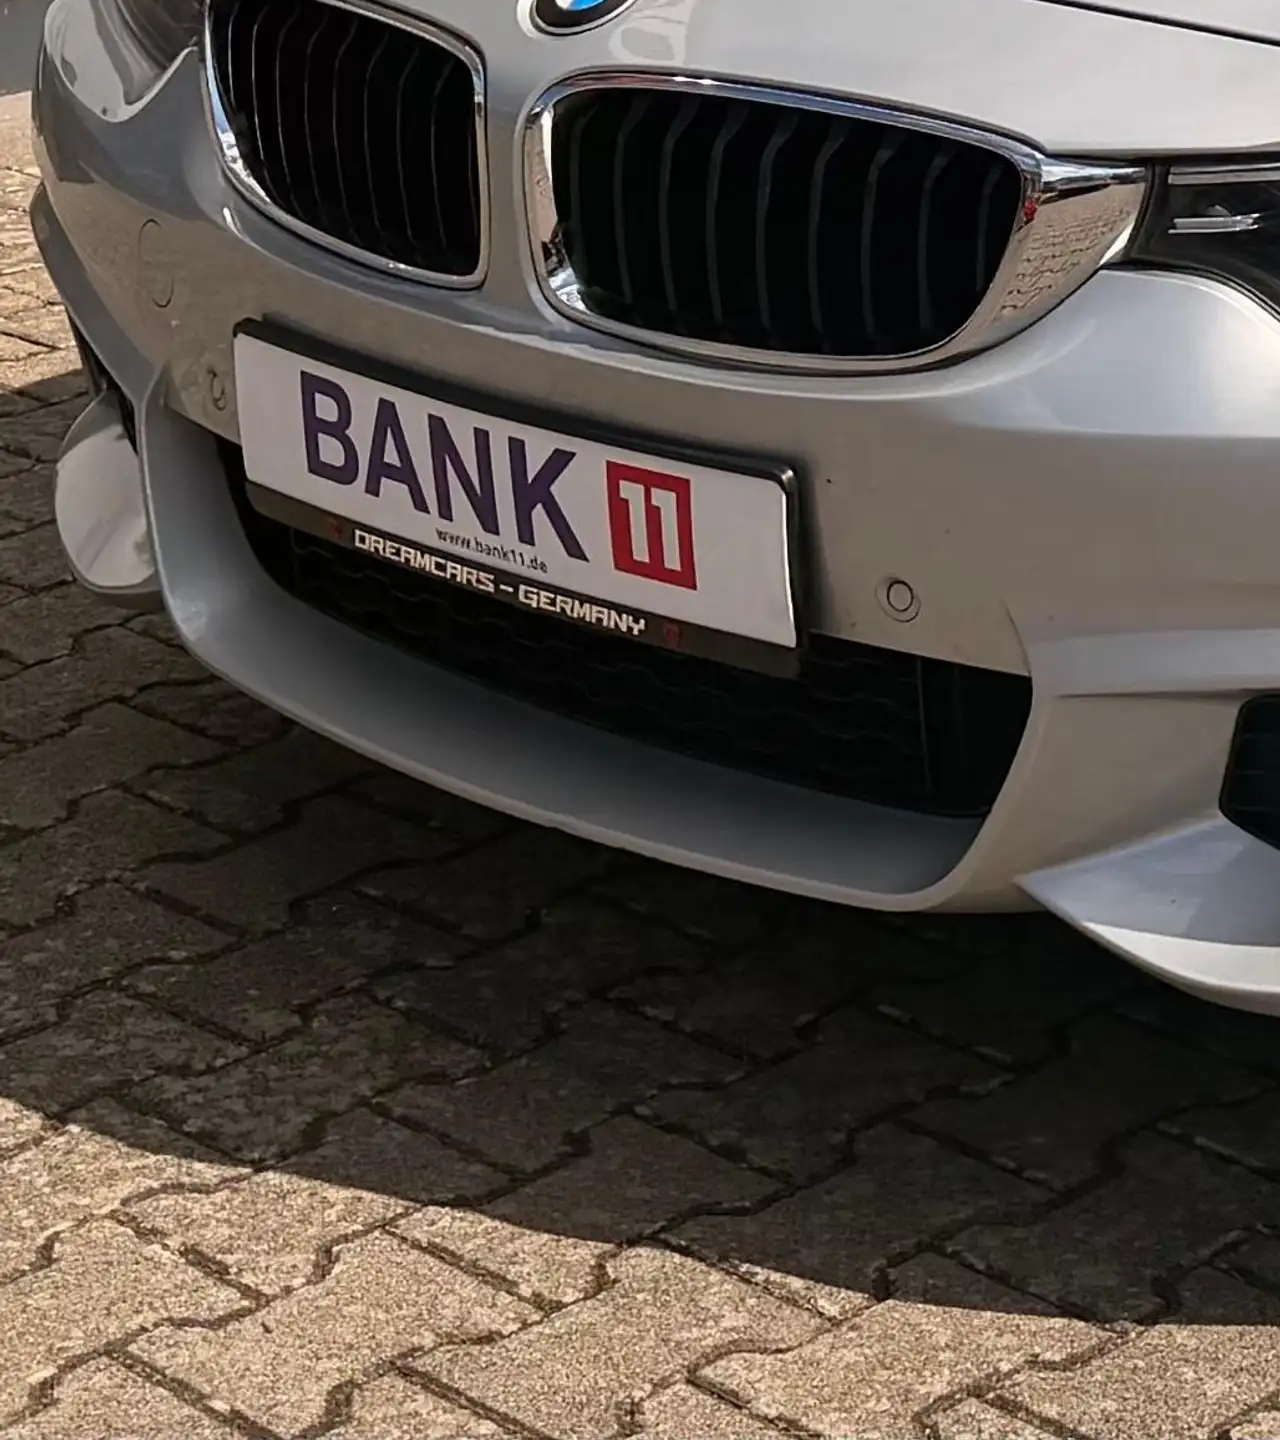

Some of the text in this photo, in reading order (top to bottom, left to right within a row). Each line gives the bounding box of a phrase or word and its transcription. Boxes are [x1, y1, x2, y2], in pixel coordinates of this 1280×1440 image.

[300, 369, 684, 573] BANK 11
[353, 528, 495, 593] DREAMCARS
[517, 582, 646, 636] GERMANY
[435, 527, 548, 574] www.bank11.de
